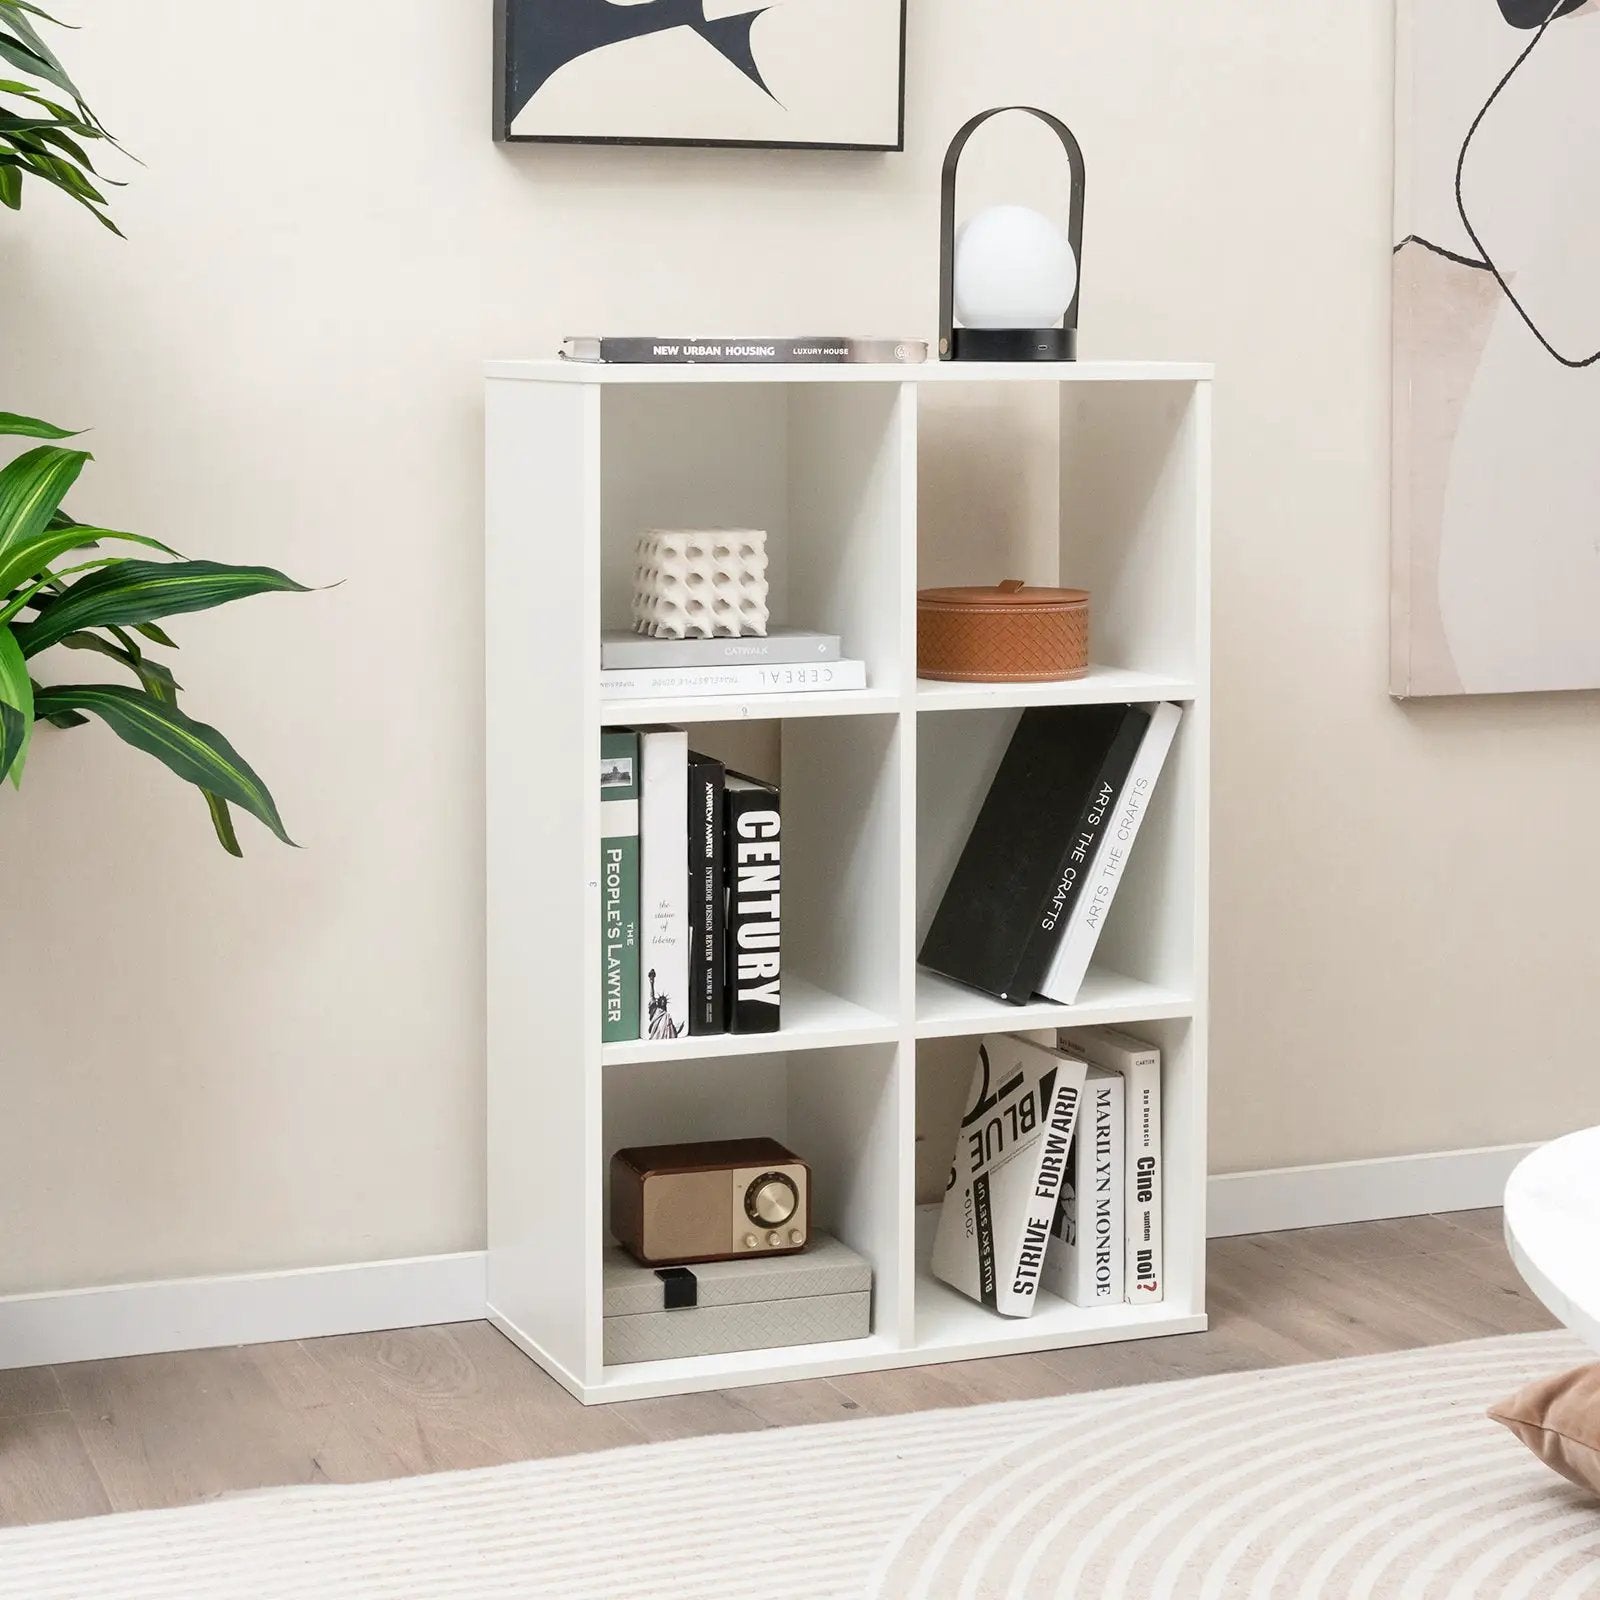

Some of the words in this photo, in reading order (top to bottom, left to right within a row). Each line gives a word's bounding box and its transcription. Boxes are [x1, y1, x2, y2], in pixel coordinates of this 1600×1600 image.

[653, 345, 679, 356] NEW
[683, 345, 721, 356] URBAN
[725, 345, 776, 356] HOUSING
[823, 347, 849, 355] HOUSE
[724, 646, 769, 657] CATWALK
[758, 668, 834, 685] CEREAL
[705, 782, 714, 822] ANDREW
[1087, 781, 1114, 826] ARTS
[705, 823, 714, 858] MARTIN
[1070, 832, 1094, 863] THE
[1085, 884, 1109, 929] ARTS
[1102, 847, 1123, 878] THE
[1117, 776, 1149, 841] CRAFTS
[607, 848, 622, 939] PEOPLE'S
[705, 866, 713, 902] INTERIOR
[1041, 867, 1076, 931] CRAFTS
[705, 904, 713, 931] DESIGN
[736, 809, 781, 1006] CENTURY
[626, 922, 634, 946] THE
[705, 934, 713, 962] REVIEW
[607, 943, 622, 1023] LAWYER
[705, 968, 713, 995] VOLUME
[968, 1090, 1036, 1173] BLUE
[1096, 1088, 1111, 1192] MARILYN
[977, 1181, 987, 1200] UP
[1012, 1216, 1049, 1295] STRIVE
[1035, 1086, 1079, 1199] FORWARD
[1137, 1156, 1156, 1203] Cine
[964, 1198, 974, 1239] 2010
[979, 1203, 989, 1227] SET
[981, 1230, 991, 1256] SKY
[1096, 1200, 1111, 1297] MONROE
[983, 1257, 993, 1293] BLUE
[1136, 1249, 1158, 1292] noi?
